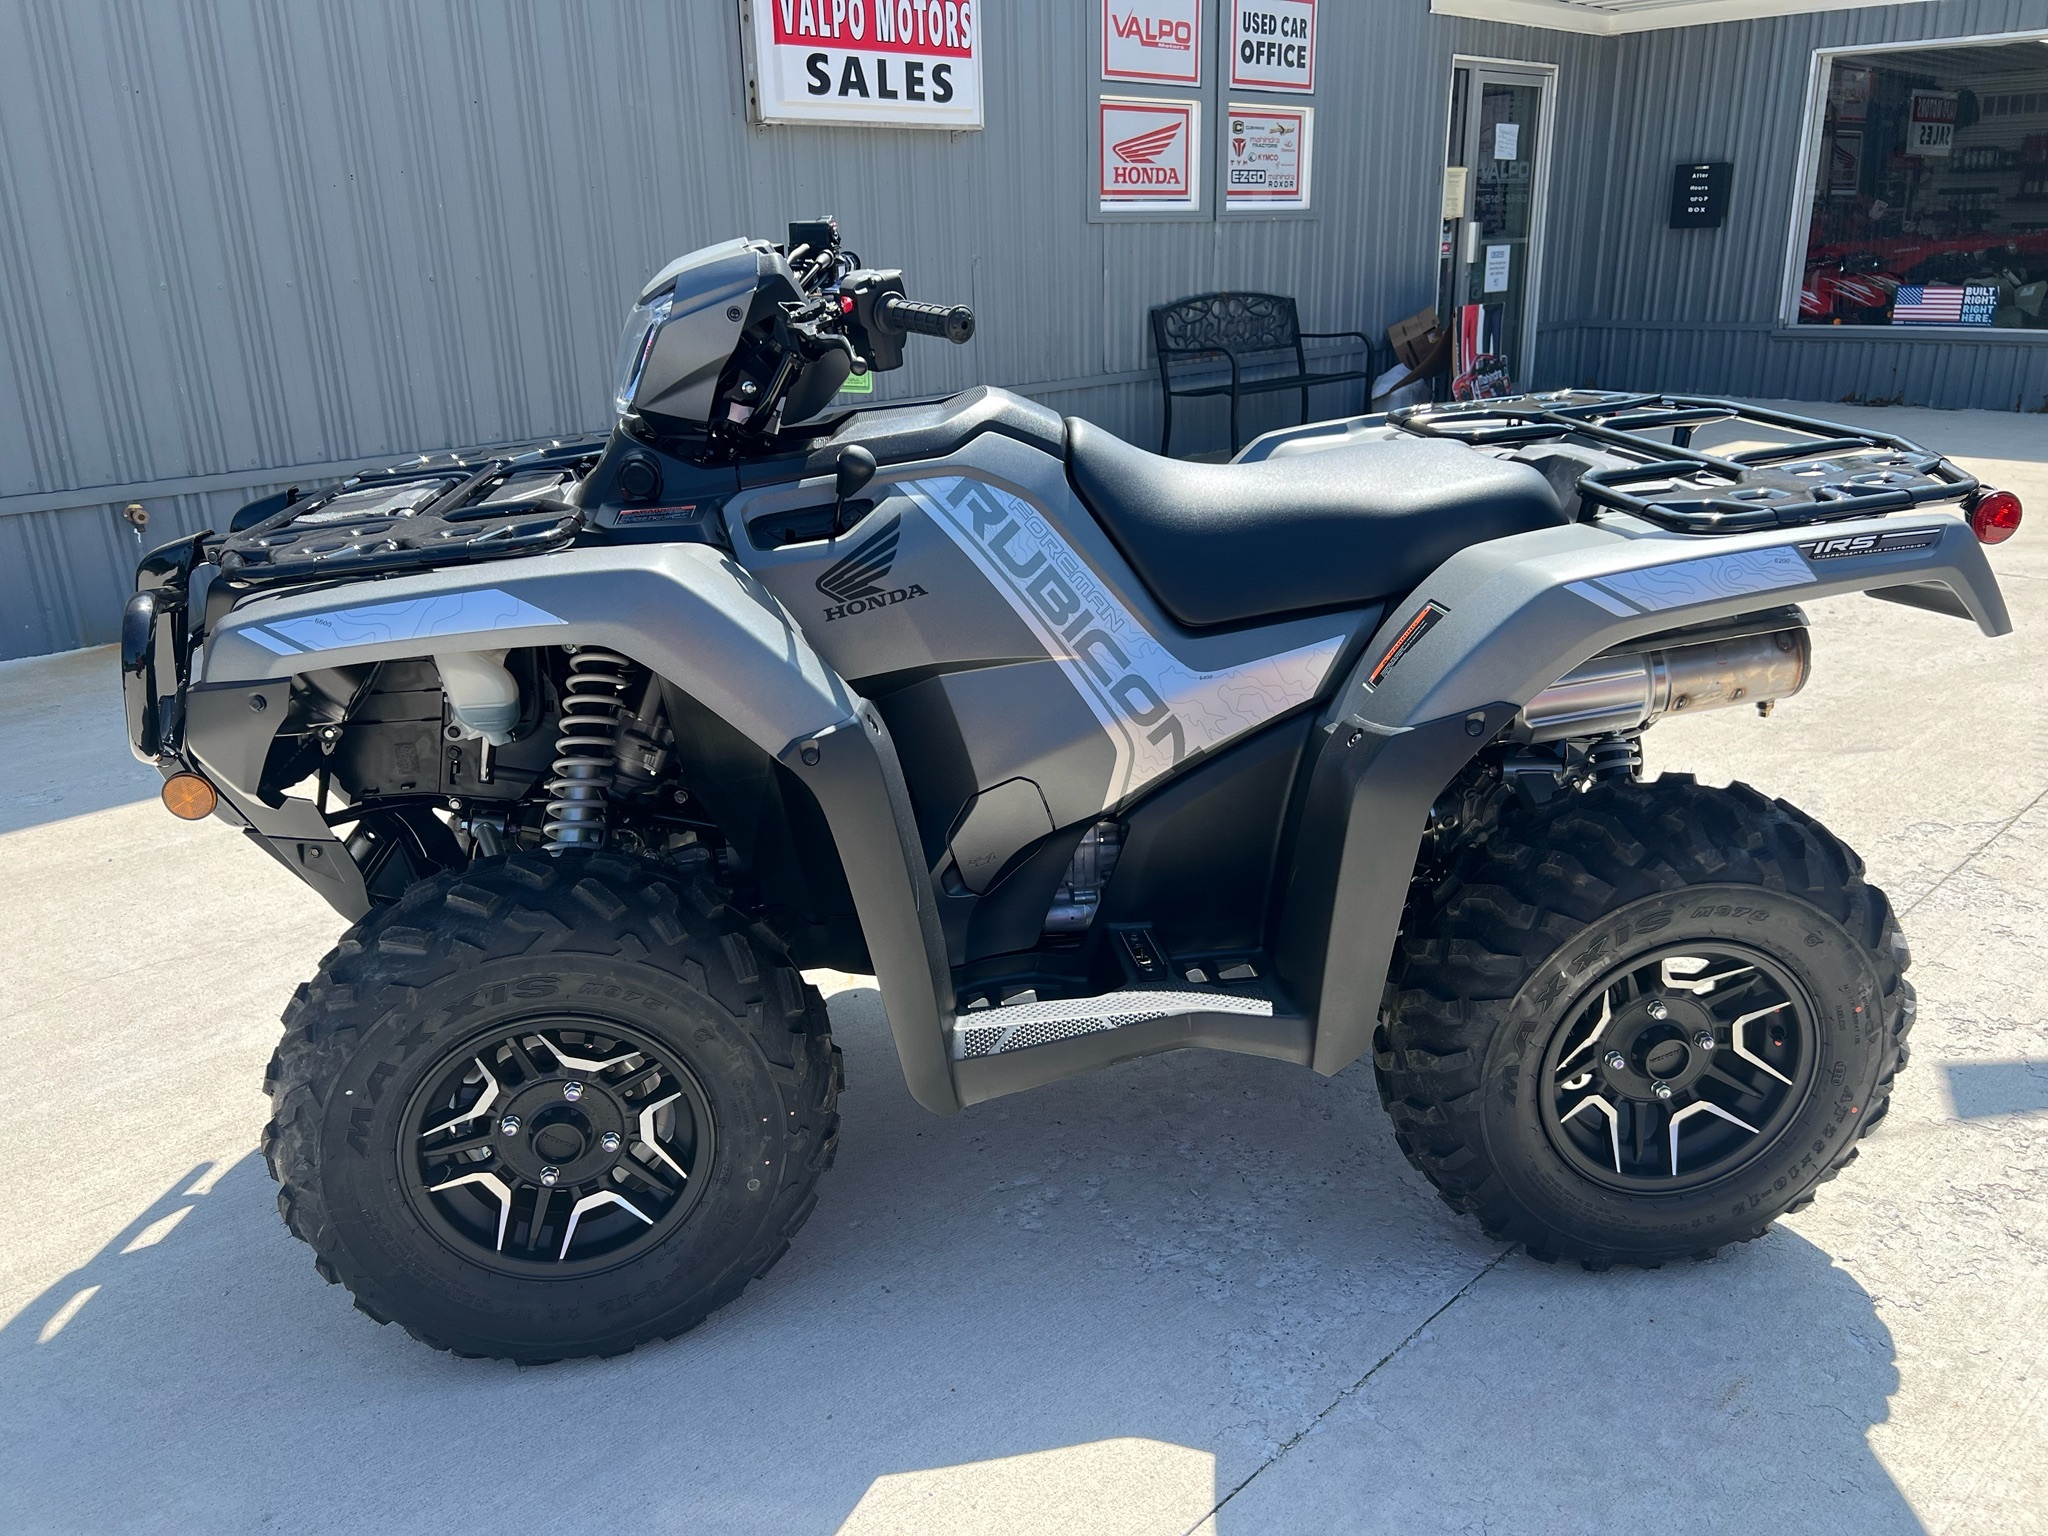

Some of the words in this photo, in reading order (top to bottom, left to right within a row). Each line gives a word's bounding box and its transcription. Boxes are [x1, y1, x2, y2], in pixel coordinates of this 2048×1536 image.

[780, 0, 865, 41] VALPO
[876, 0, 972, 49] MOTORS
[1111, 8, 1192, 46] VALPO
[1242, 11, 1277, 36] USED
[1281, 16, 1307, 39] CAR
[1157, 42, 1185, 50] Motors
[1240, 39, 1307, 69] OFFICE
[806, 52, 954, 104] SALES
[1250, 136, 1280, 144] mahindra
[1113, 166, 1181, 185] HONDA
[1267, 173, 1295, 181] mahindra
[1268, 180, 1294, 188] ROXOR
[1963, 295, 1997, 305] RIGHT.
[1965, 286, 1996, 296] BUILT
[1961, 314, 1992, 323] HERE.
[1962, 305, 1995, 314] RIGHT
[1813, 535, 1878, 554] IRS
[1813, 550, 1863, 559] INDEPENDENT
[1883, 543, 1926, 552] SUSPENSION
[1008, 496, 1126, 633] FOREMAN
[823, 583, 929, 622] HONDA
[314, 617, 333, 628] 6600
[945, 475, 1205, 771] RUBICON
[1500, 909, 1674, 1107] MAXXIS
[1690, 904, 1771, 922] M978
[346, 976, 560, 1157] MAXXIS
